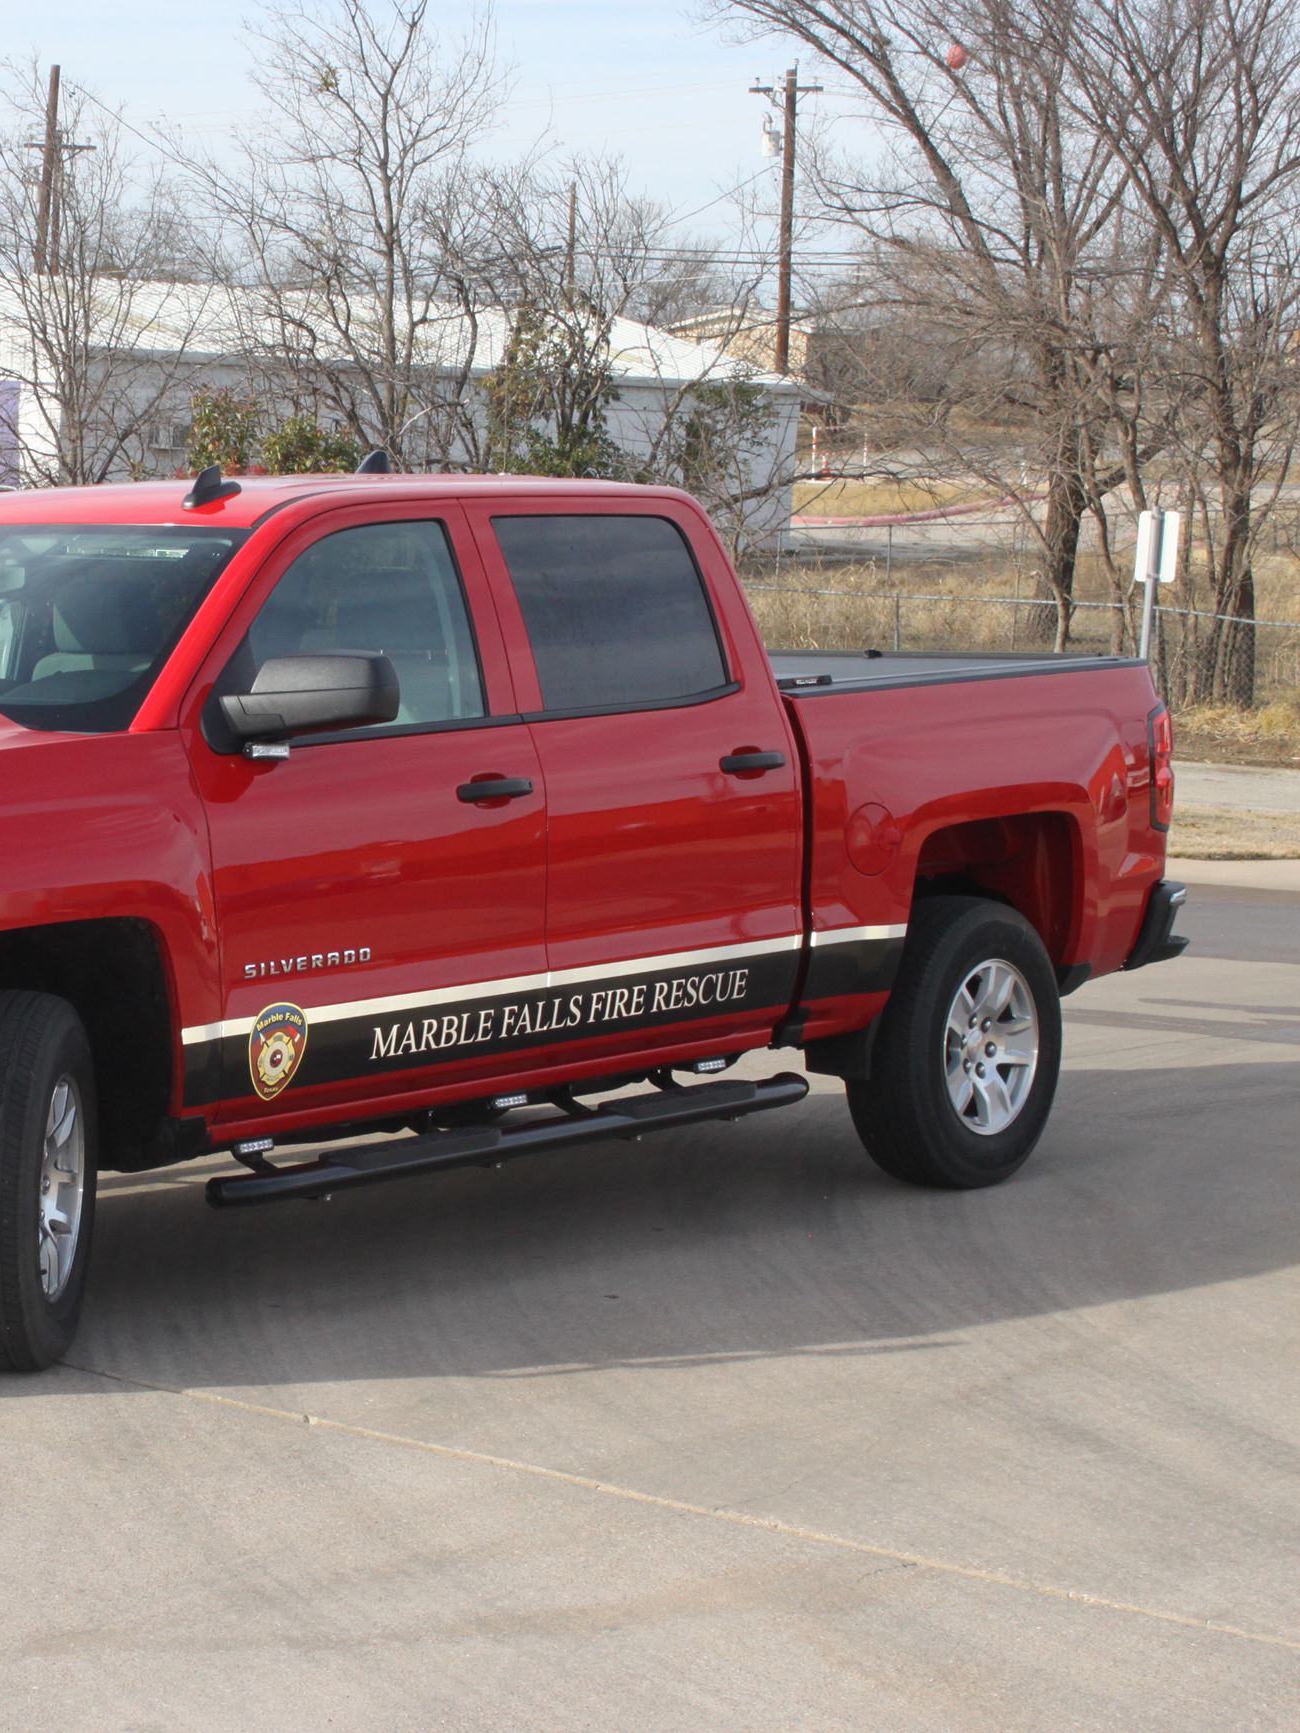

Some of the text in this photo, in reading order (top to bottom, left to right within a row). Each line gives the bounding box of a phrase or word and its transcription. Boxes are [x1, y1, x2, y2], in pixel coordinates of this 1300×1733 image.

[244, 947, 371, 979] SILVERADO
[256, 1012, 302, 1031] Marble Falls
[369, 969, 749, 1060] MARBLE FALLS FIRE RESCUE
